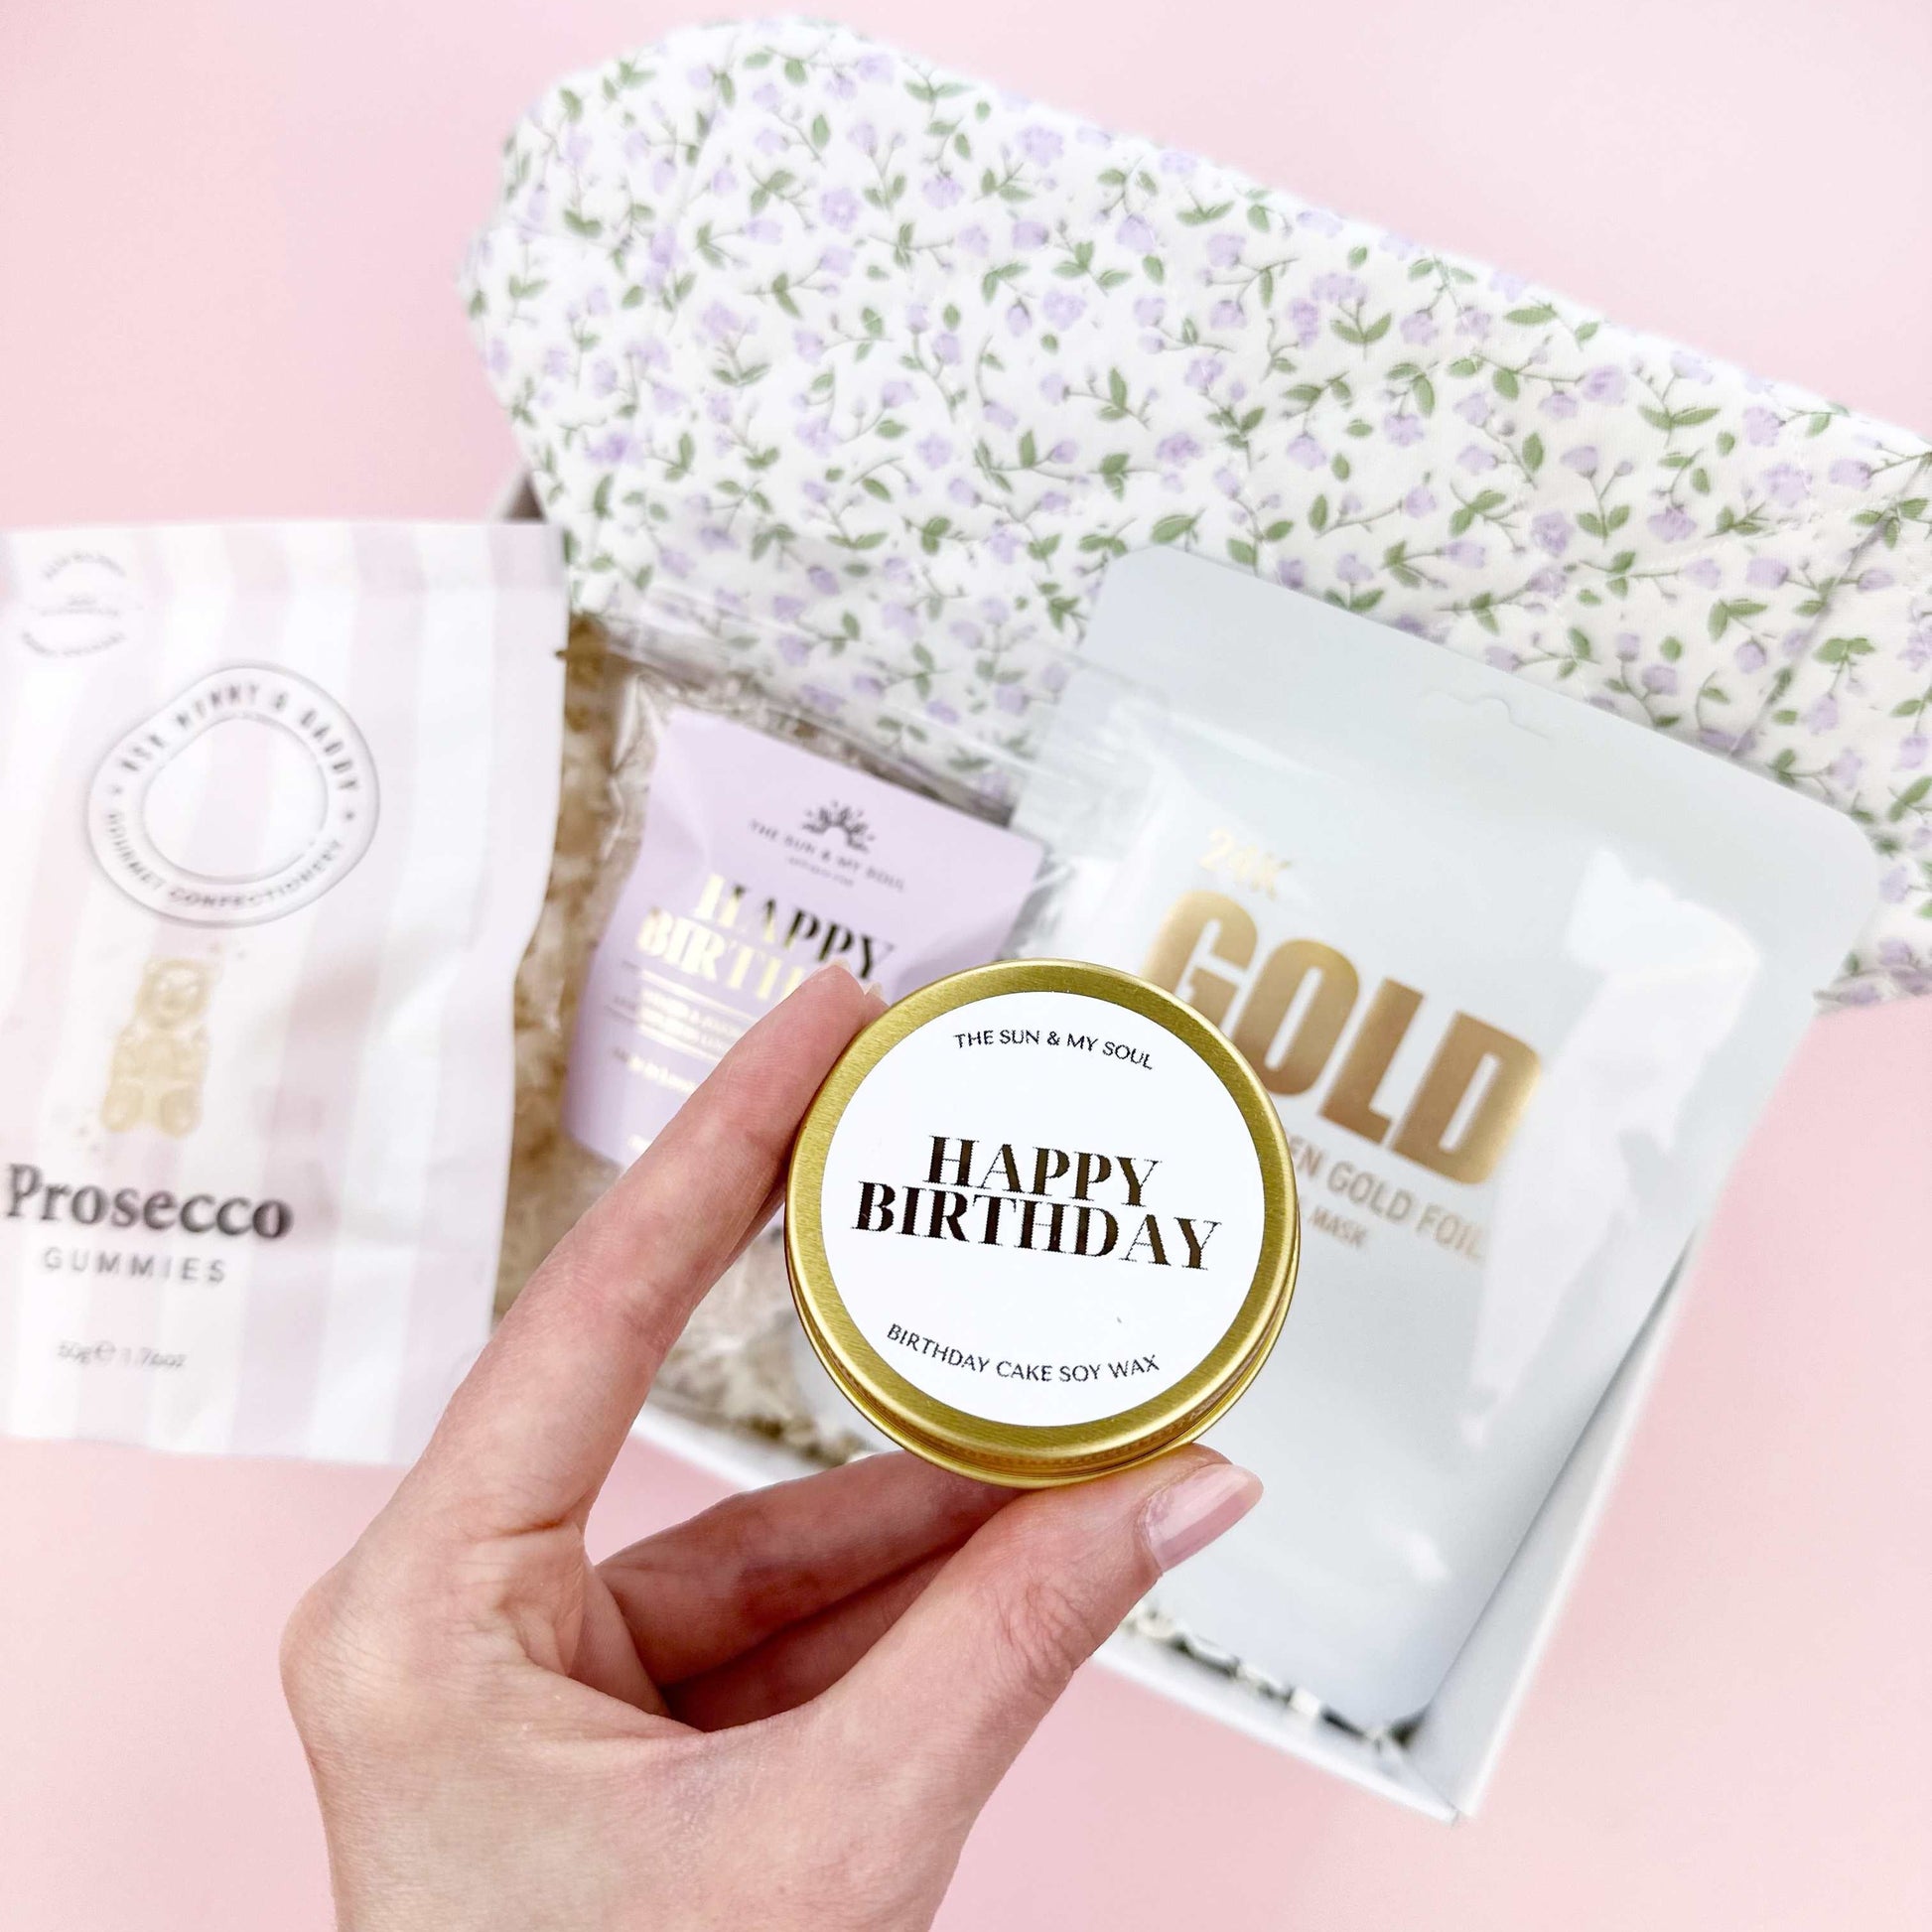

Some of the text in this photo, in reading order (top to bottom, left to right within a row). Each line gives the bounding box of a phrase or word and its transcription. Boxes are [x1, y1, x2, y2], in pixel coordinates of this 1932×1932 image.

[749, 818, 779, 840] THE
[1197, 827, 1292, 898] 24K
[169, 838, 342, 907] CONFECTIONERY
[636, 904, 803, 1002] BIRTH
[690, 873, 897, 979] HAPPY
[953, 1029, 1154, 1070] THE SUN & MY SOUL
[1141, 890, 1542, 1185] GOLD
[2, 1161, 295, 1242] Prosecco
[923, 1134, 1163, 1207] HAPPY
[851, 1179, 1223, 1271] BIRTHDAY
[1309, 1205, 1368, 1248] MASK
[1326, 1161, 1483, 1261] GOLD FOIL
[43, 1247, 227, 1285] GUMMIES
[887, 1322, 1161, 1382] BIRTHDAY CAKE SOY WAX
